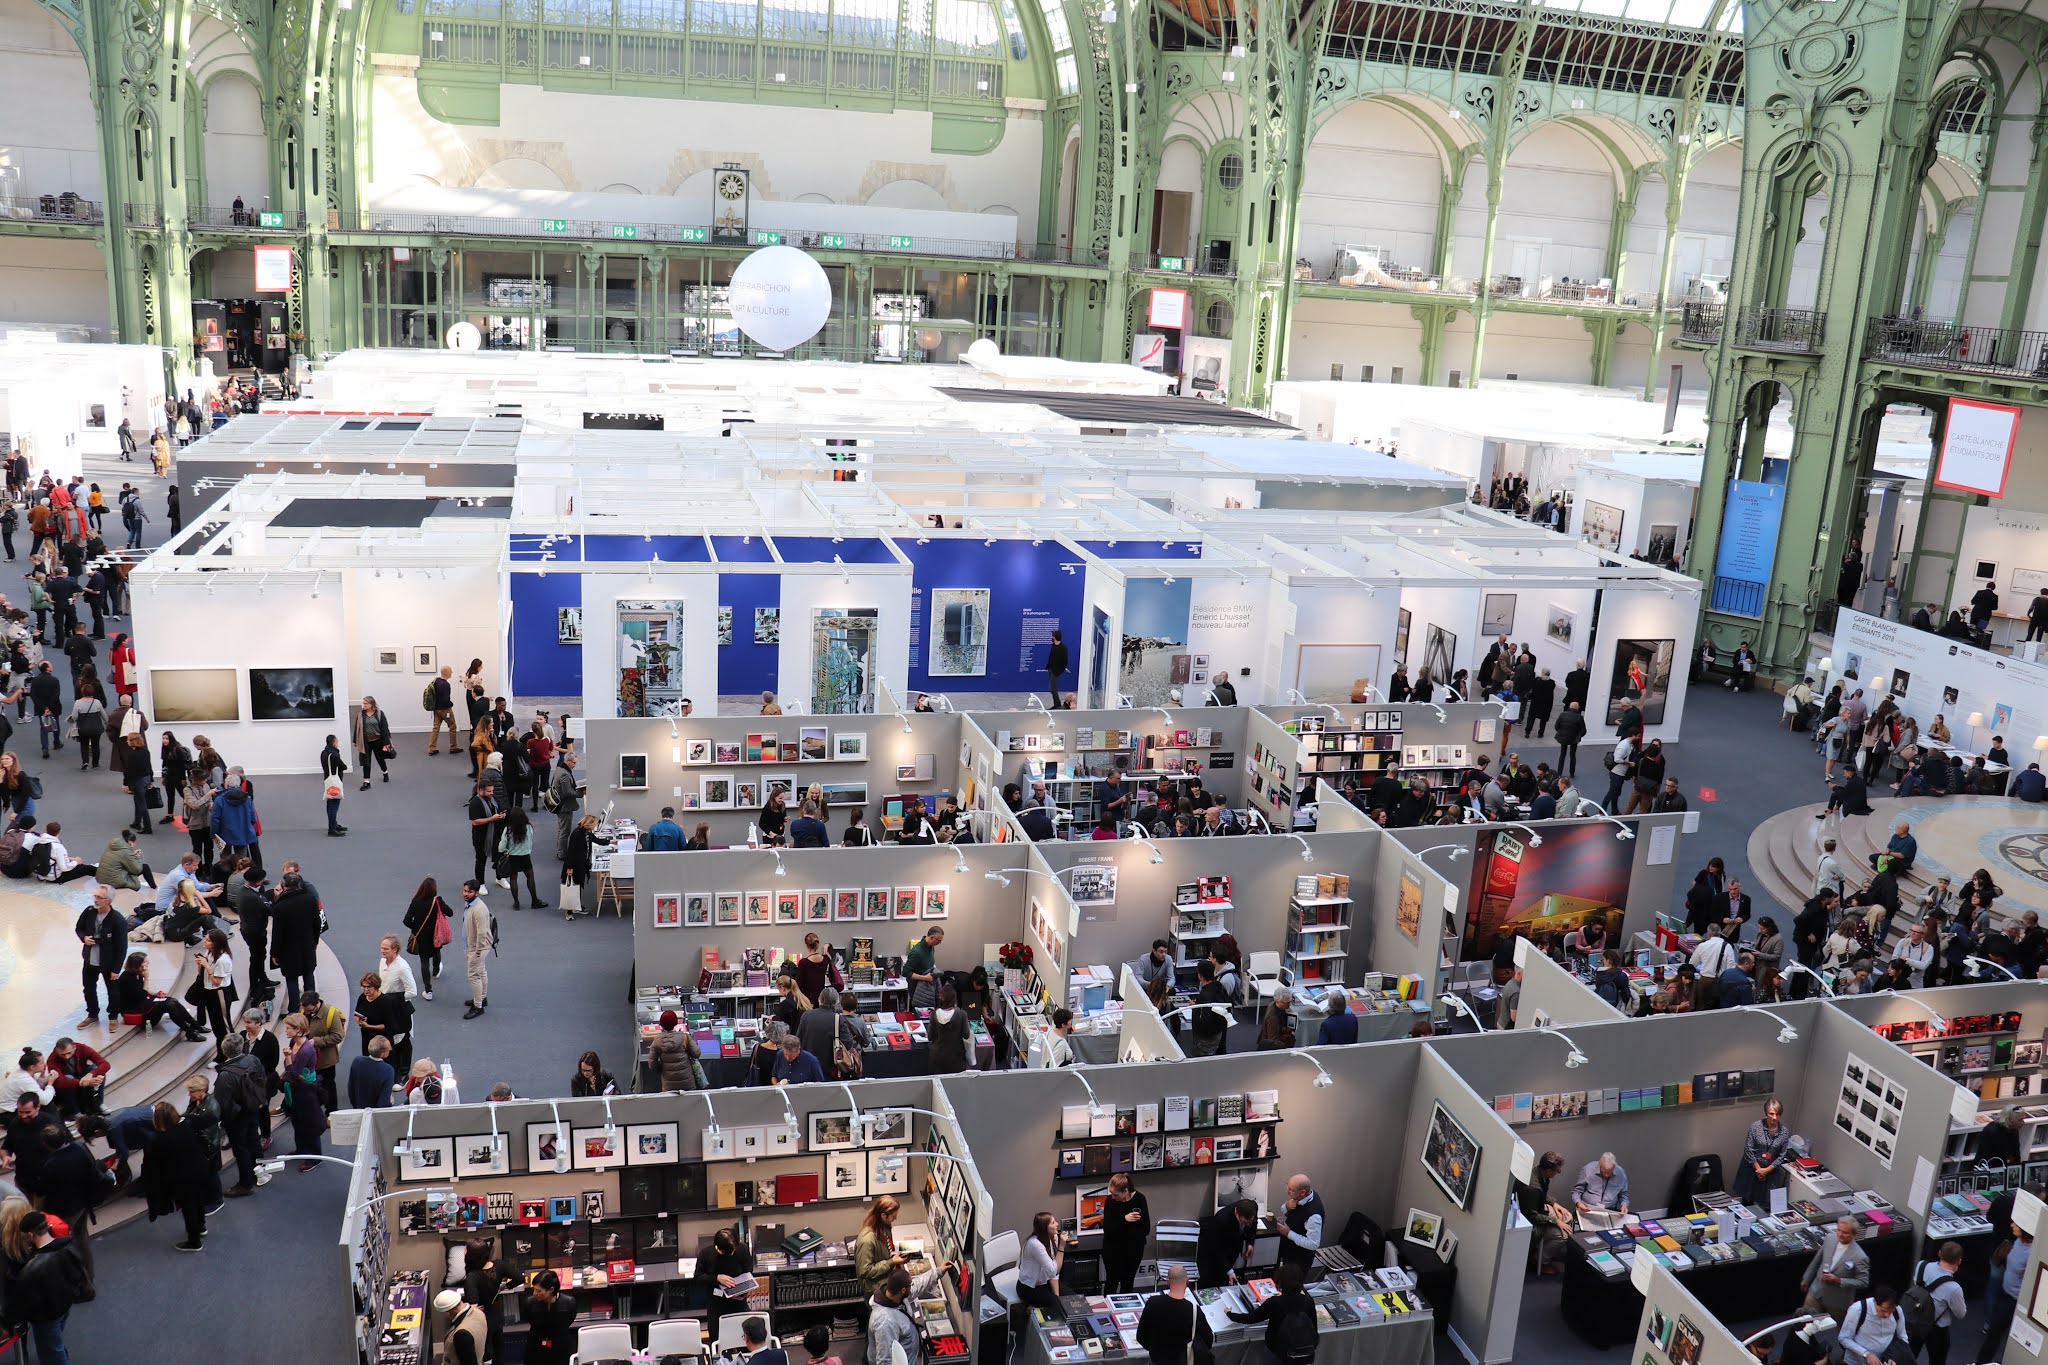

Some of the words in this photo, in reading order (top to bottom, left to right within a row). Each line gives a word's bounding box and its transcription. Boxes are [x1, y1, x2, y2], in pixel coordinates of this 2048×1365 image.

[747, 282, 791, 293] RABICHON
[752, 306, 790, 316] CULTURE
[1951, 433, 1972, 443] CARTE
[1972, 436, 2005, 448] BLANCHE
[1985, 452, 2001, 461] 2018
[1193, 605, 1232, 613] Résidence
[1192, 613, 1218, 621] Emeric
[1224, 621, 1250, 629] lauréat
[1853, 615, 1871, 626] CARTE
[1871, 620, 1898, 634] BLANCHE
[1851, 623, 1881, 638] ÉTUDIANTS
[1881, 633, 1895, 643] 2018
[1501, 835, 1521, 850] DAIRY
[1677, 1321, 1699, 1347] CAMP
